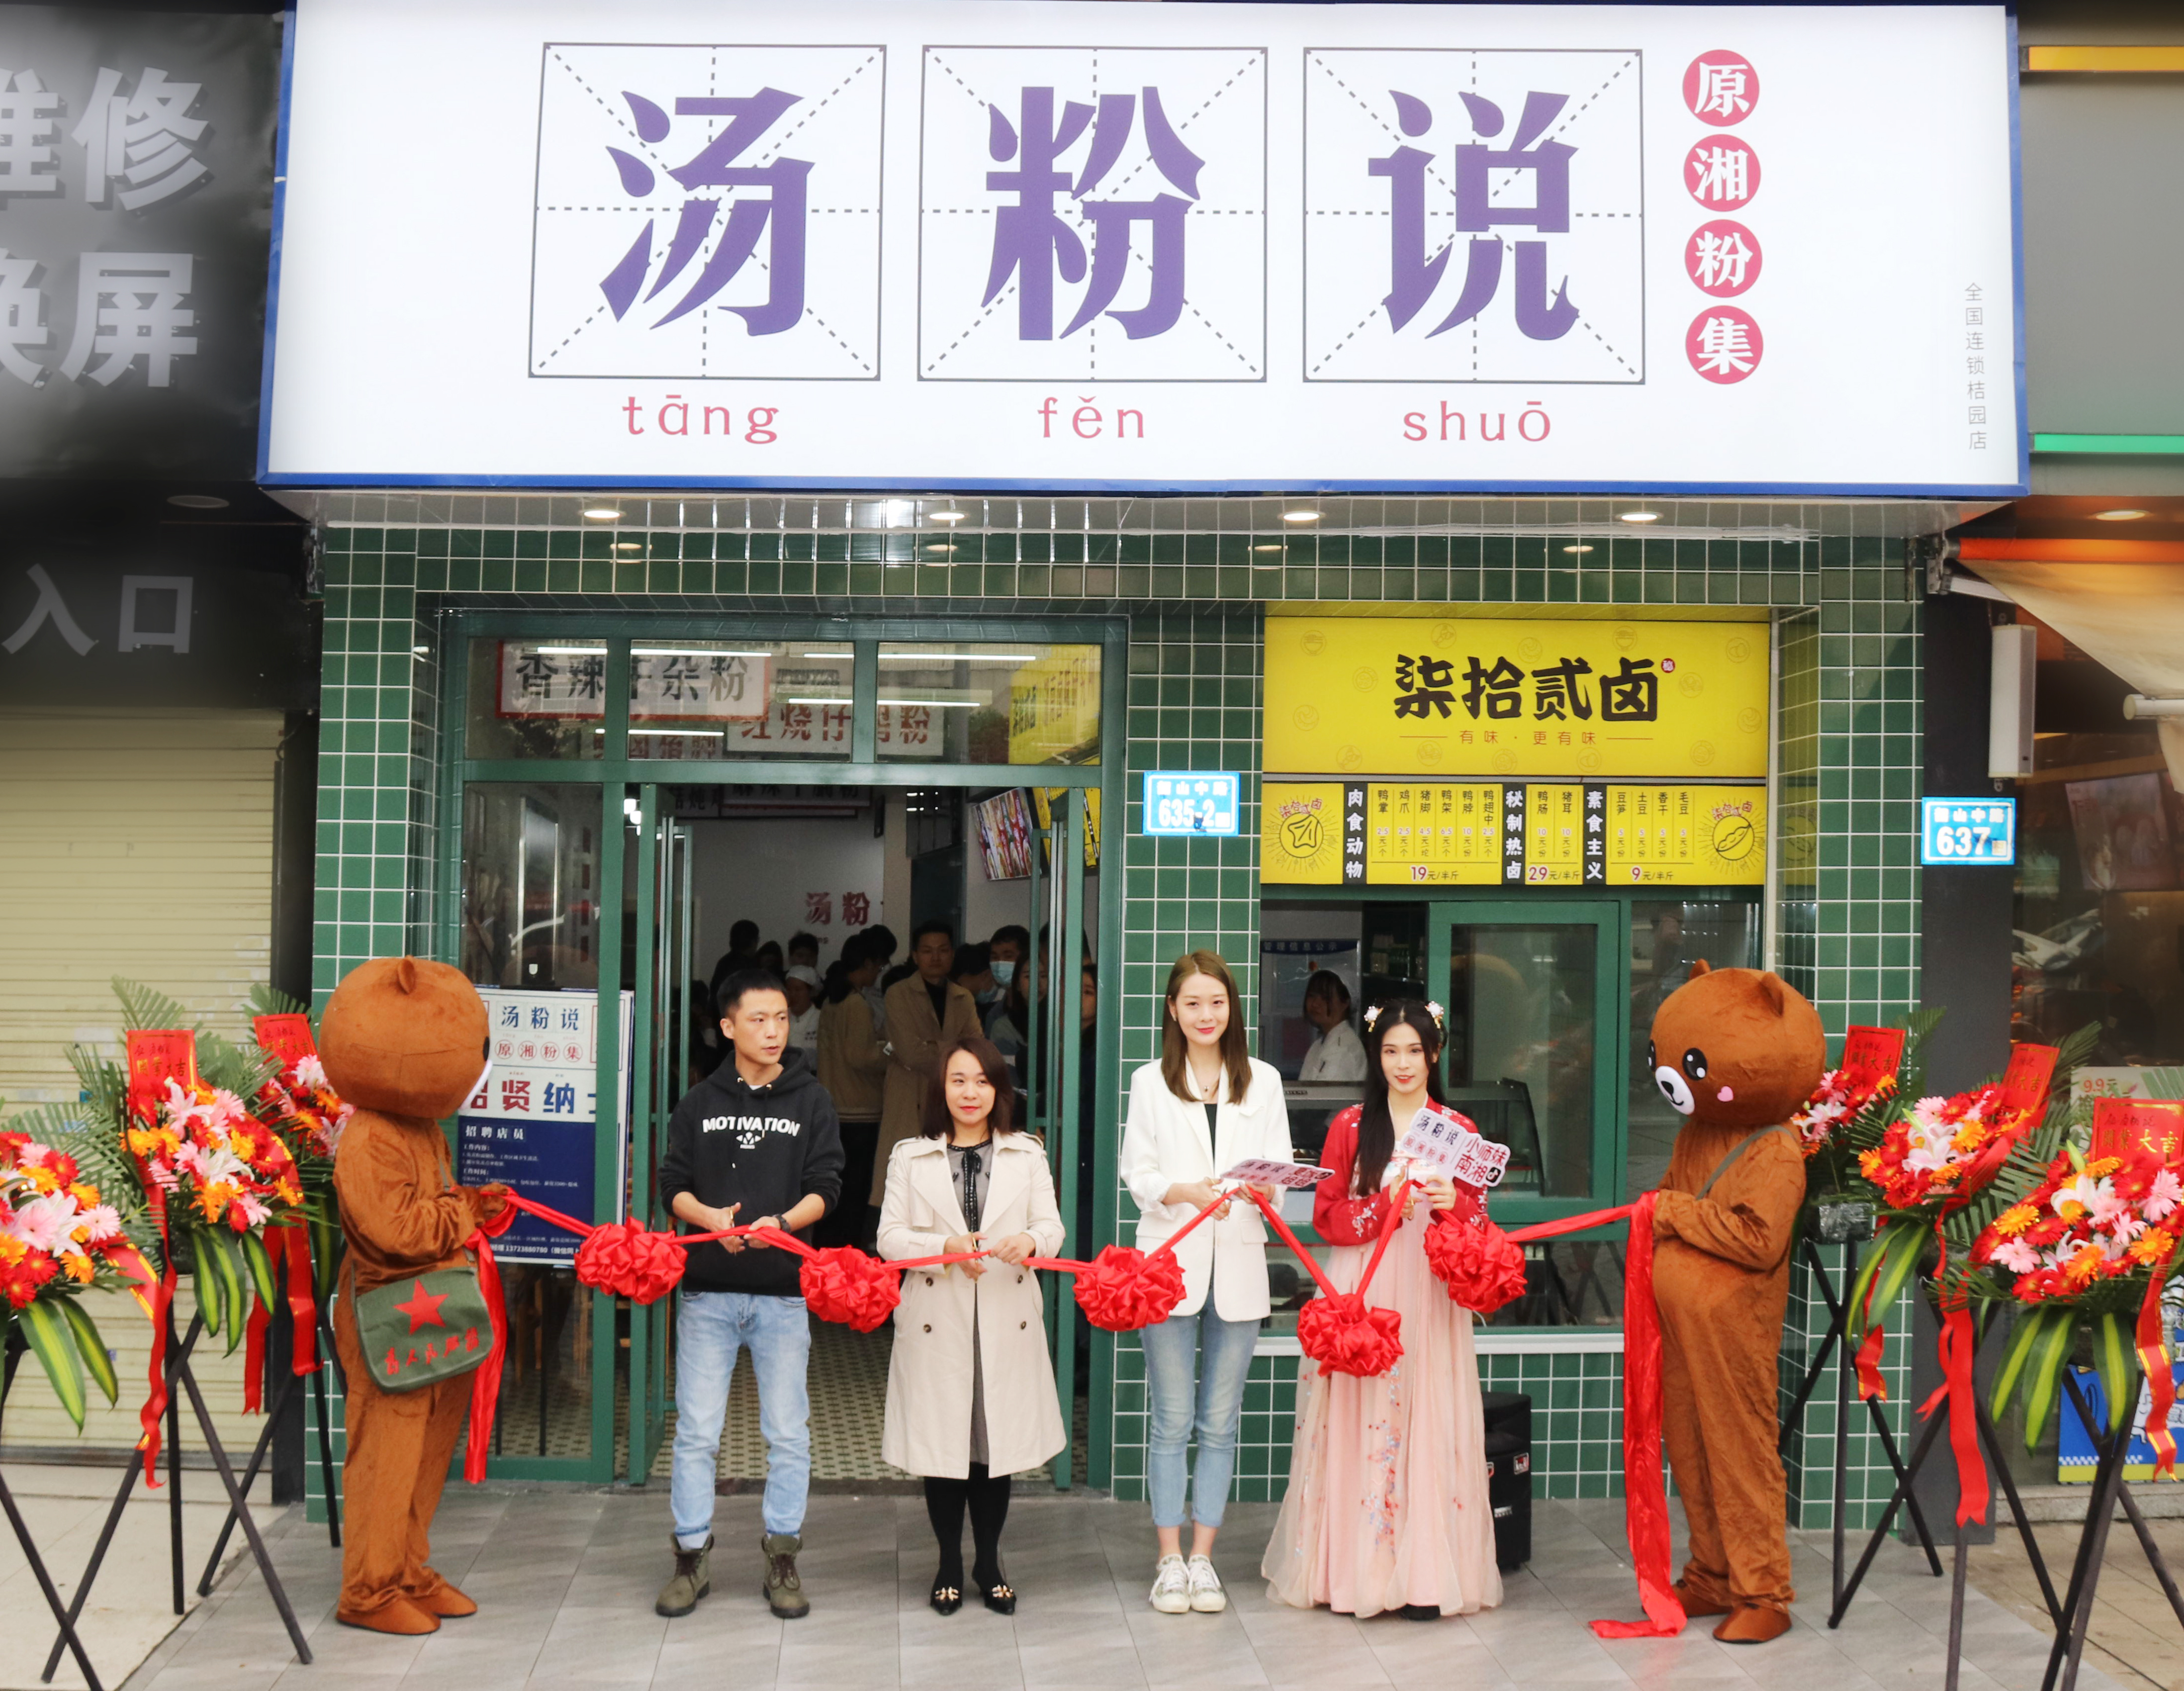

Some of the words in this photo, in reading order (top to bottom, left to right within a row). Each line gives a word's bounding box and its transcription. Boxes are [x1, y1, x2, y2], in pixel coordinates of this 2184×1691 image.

[599, 87, 1579, 341] 汤粉说
[1693, 62, 1754, 376] 原湘粉集
[1964, 282, 1987, 450] 全国连锁桔园店
[622, 394, 779, 445] tāng
[1402, 400, 1551, 442] shuō
[1, 564, 193, 657] 入口
[1394, 654, 1658, 722] 柒拾贰卤
[1378, 789, 1388, 814] 鸭掌
[1399, 789, 1410, 814] 鸡爪
[1420, 790, 1431, 814] 猪脚
[1442, 790, 1452, 814] 鸭架
[1462, 790, 1473, 814] 鸭脖
[1483, 790, 1494, 826] 鸭翅中
[1562, 791, 1572, 814] 猪耳
[1346, 789, 1364, 879] 肉食动物
[1506, 790, 1523, 879] 秘制热卤
[1586, 790, 1604, 880] 素食主义
[1936, 826, 1991, 855] 637
[501, 1005, 579, 1031] 汤粉说
[498, 1042, 581, 1061] 原湘粉集
[465, 1125, 524, 1140] 招聘店员
[702, 1116, 801, 1137] MOTIVATION
[1417, 1115, 1459, 1145] 汤粉说
[1465, 1137, 1507, 1166] 小师妹
[1454, 1153, 1488, 1183] 南湘
